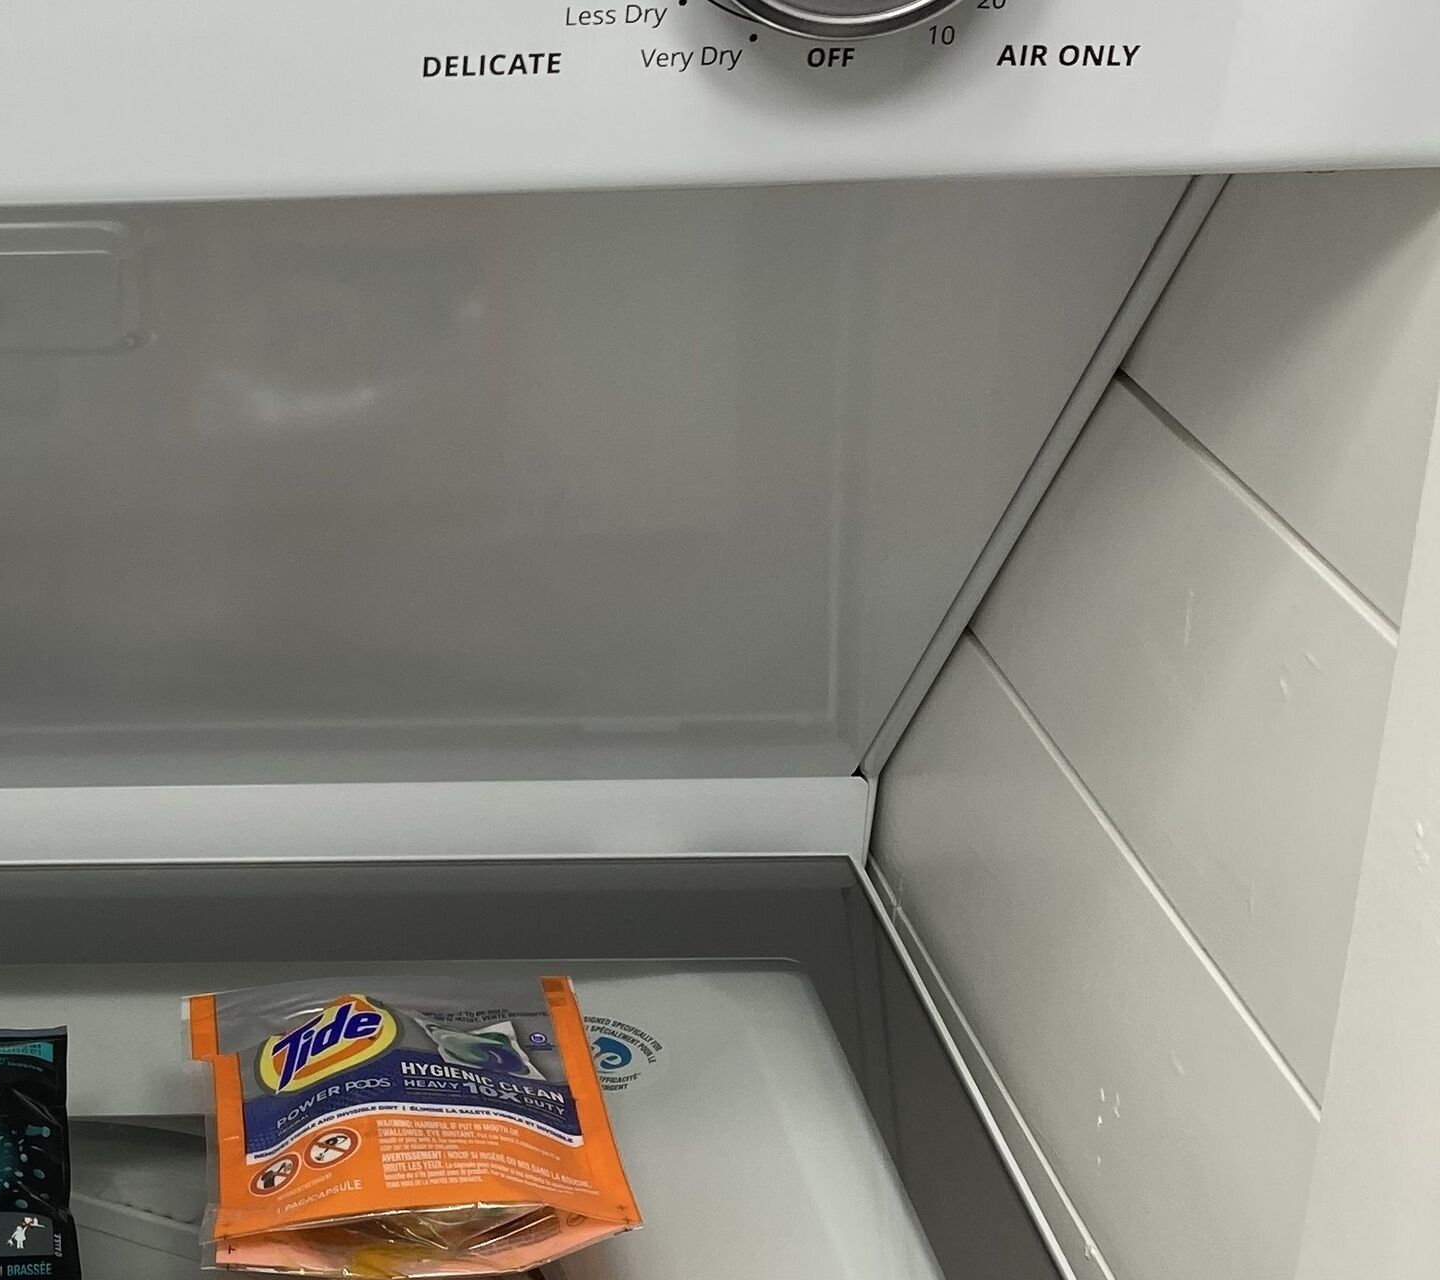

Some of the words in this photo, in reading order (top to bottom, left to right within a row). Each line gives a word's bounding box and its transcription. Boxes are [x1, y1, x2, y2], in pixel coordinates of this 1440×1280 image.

[565, 6, 616, 26] Less
[625, 4, 669, 29] Dry
[928, 24, 956, 46] 10
[422, 52, 562, 78] DELICATE
[641, 48, 696, 74] Very
[700, 46, 744, 71] Dry
[806, 47, 856, 68] OFF
[996, 44, 1048, 67] AIR
[1058, 44, 1141, 67] ONLY
[611, 1020, 654, 1043] SPECIFICALLY
[271, 1001, 383, 1093] Tide
[402, 1061, 495, 1088] HYGIENIC
[499, 1081, 565, 1104] CLEAN
[277, 1085, 340, 1129] POWER
[345, 1078, 391, 1092] PODS
[404, 1079, 460, 1091] HEAVY
[462, 1082, 522, 1105] 10X
[524, 1096, 565, 1116] DUTY
[381, 1150, 442, 1163] AVERTISSEMENT
[407, 1161, 422, 1171] LES
[285, 1179, 363, 1212] PAC/CAPSULE
[6, 1261, 53, 1277] BRASSÉE
